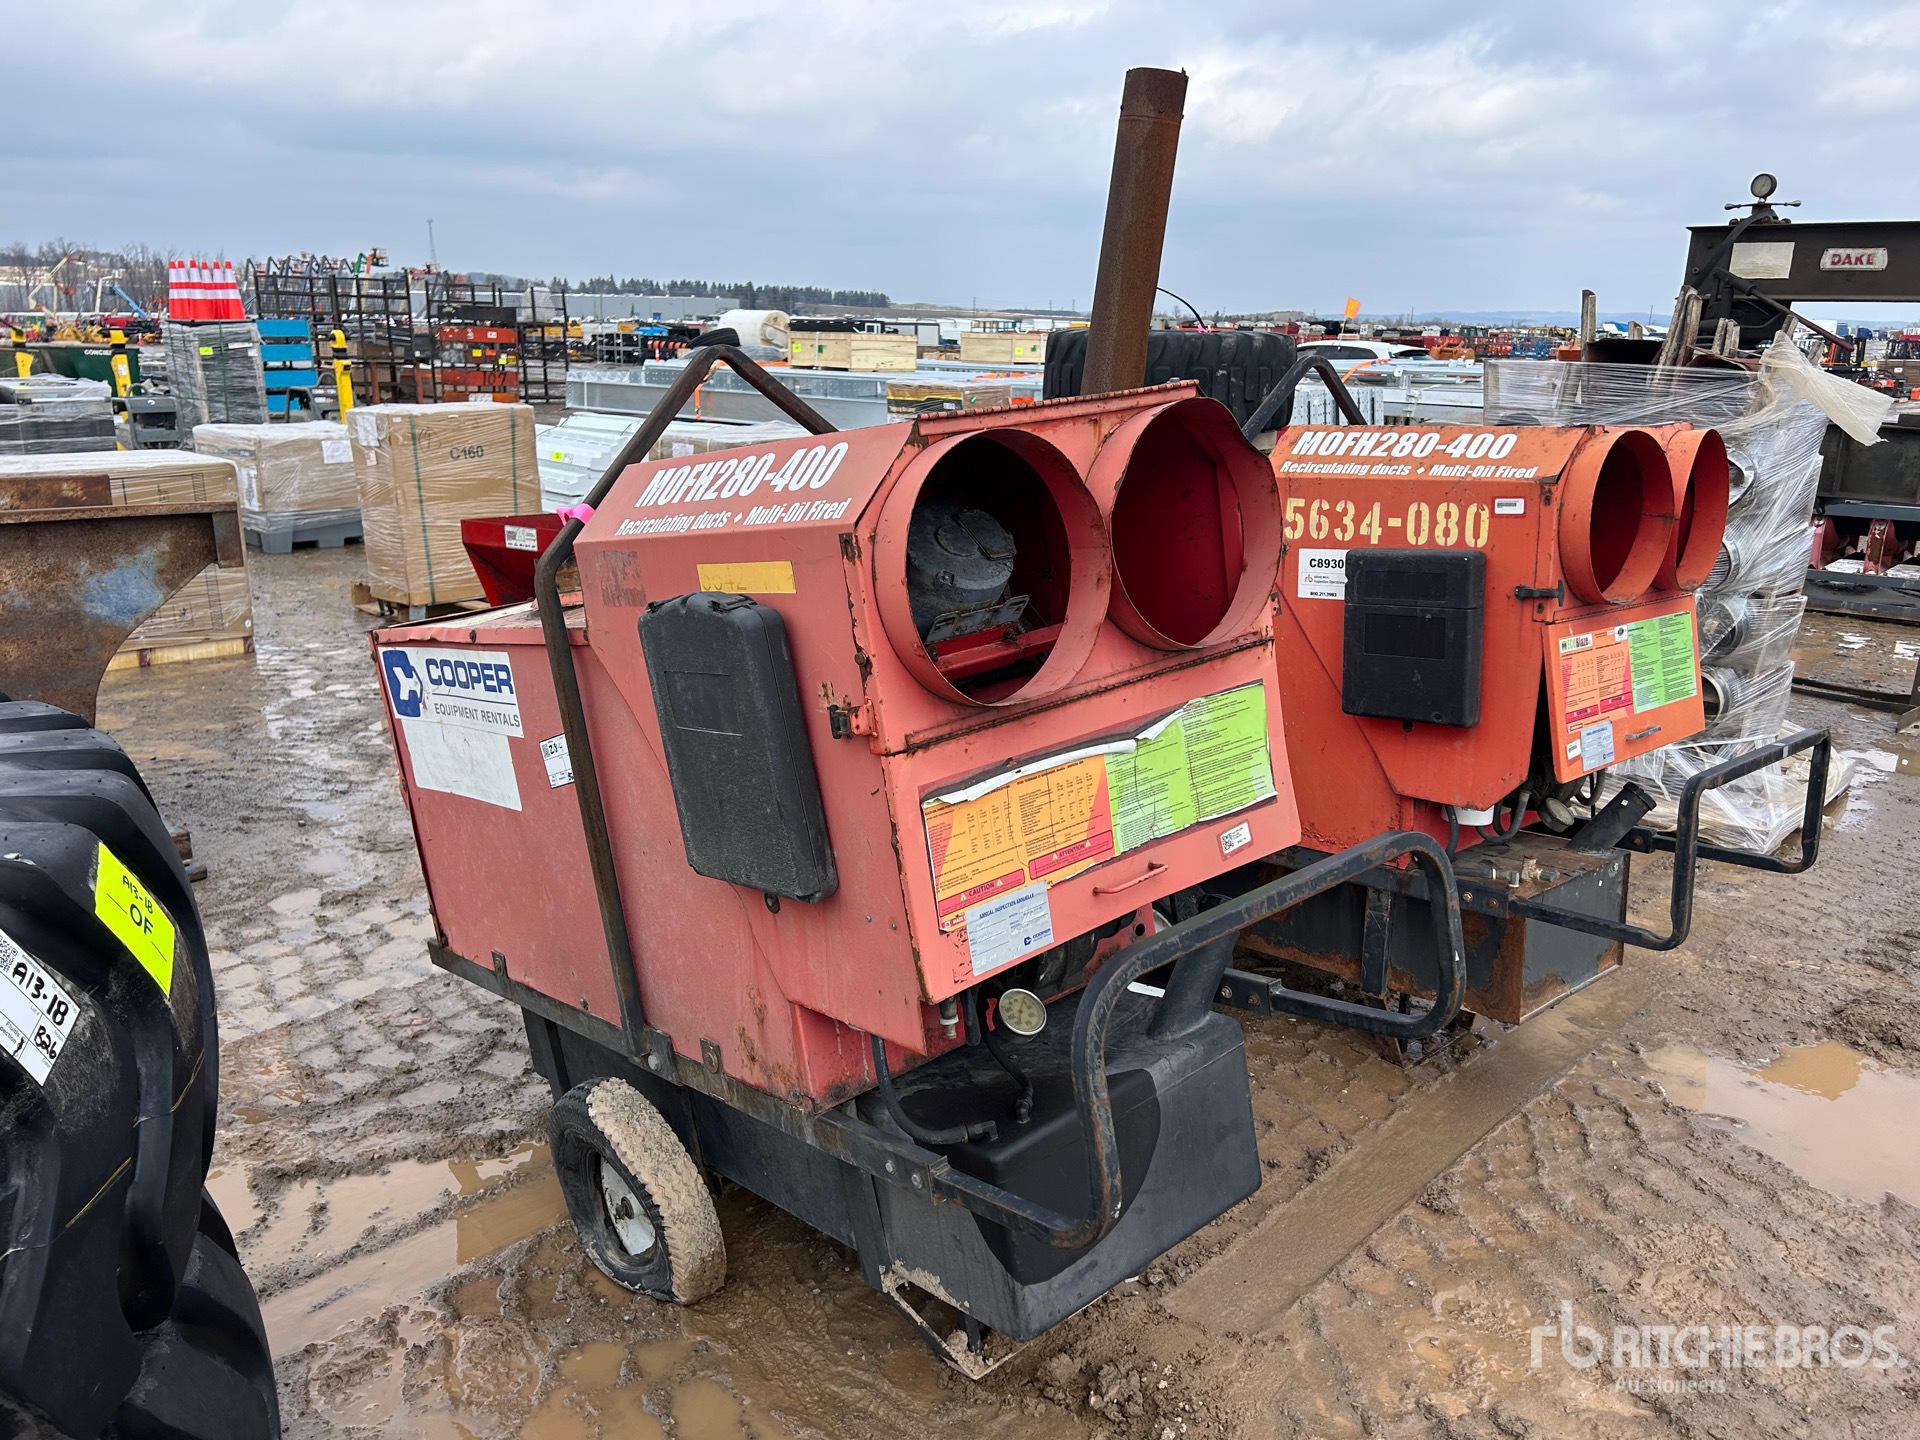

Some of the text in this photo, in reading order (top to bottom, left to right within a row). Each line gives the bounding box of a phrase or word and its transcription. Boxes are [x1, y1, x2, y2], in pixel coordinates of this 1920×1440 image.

[1830, 253, 1875, 266] DAKE
[450, 445, 484, 461] C160
[1291, 431, 1518, 459] MOFH280-400
[634, 441, 849, 507] MOFH280-400
[1280, 461, 1538, 479] Recirculating ducts Multi-Oil Fired
[614, 497, 853, 536] Recirculating ducts Multi-Oil Fired
[1284, 498, 1490, 548] 5634-080
[1309, 558, 1345, 569] C8930
[425, 658, 515, 695] COOPER
[434, 702, 521, 728] EQUIPMENT RENTALS
[1058, 844, 1086, 858] ATTENTION
[968, 883, 995, 897] CAUTION
[994, 900, 1017, 913] INSPECTION
[1016, 893, 1035, 905] ANNUELLE
[129, 903, 154, 935] OF
[5, 1020, 21, 1038] Fluids
